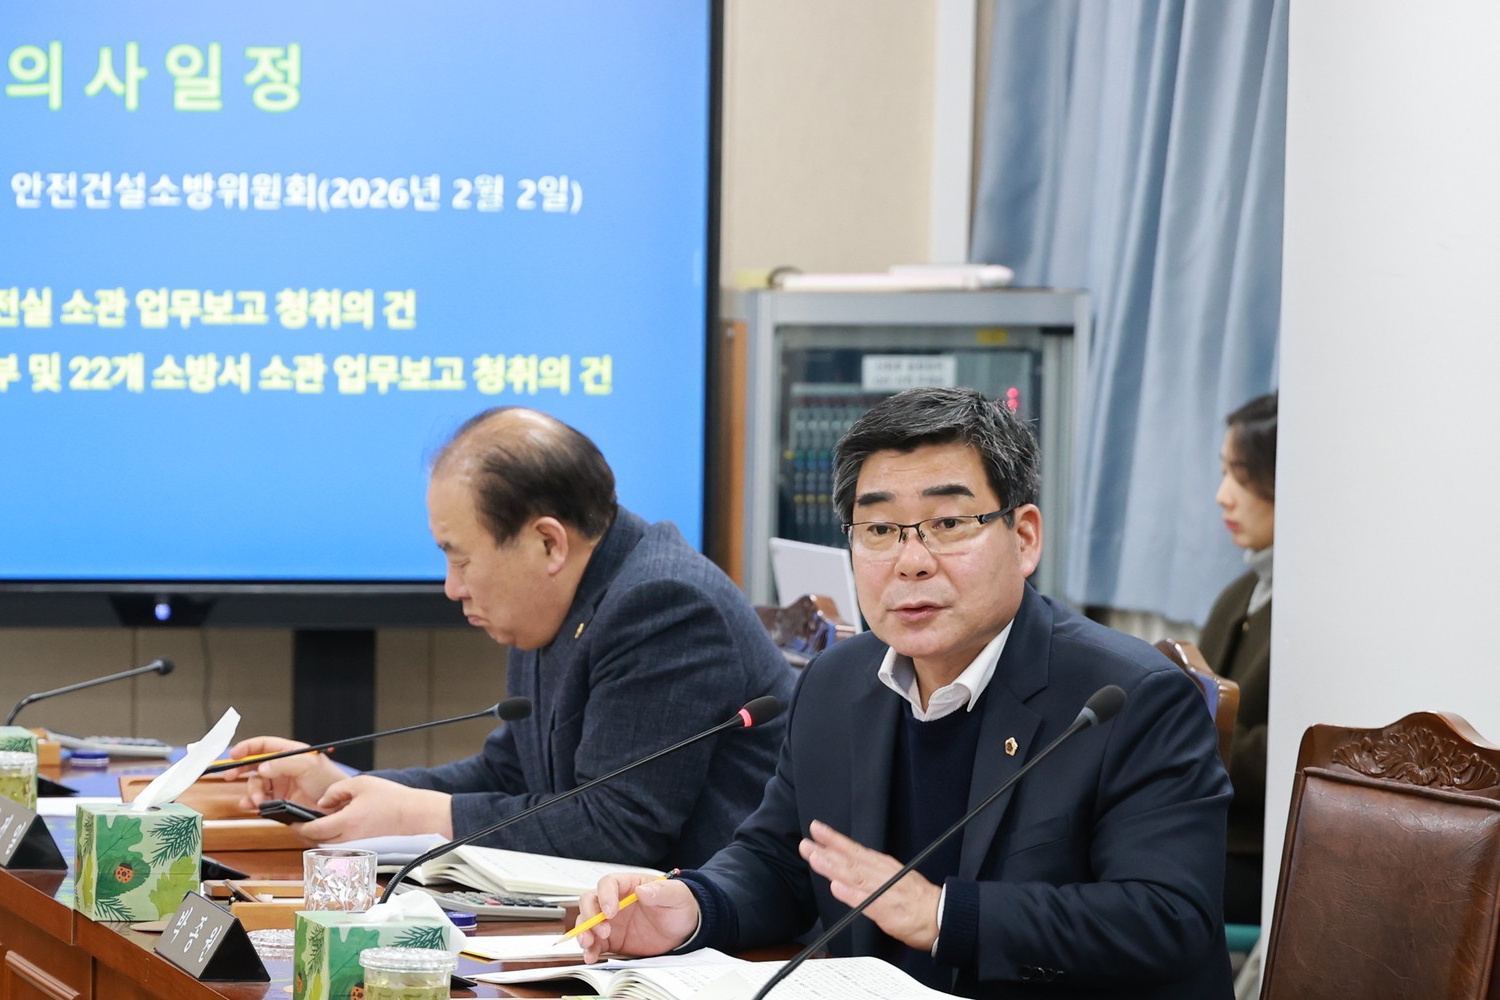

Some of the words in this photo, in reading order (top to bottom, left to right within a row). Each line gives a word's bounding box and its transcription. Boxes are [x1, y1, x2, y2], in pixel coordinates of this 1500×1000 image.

[5, 40, 301, 113] 의사일정
[451, 174, 505, 212] 2월
[516, 174, 584, 215] 2일)
[60, 288, 127, 328] 소관
[135, 287, 268, 329] 업무보고
[275, 287, 375, 330] 청취의
[382, 289, 417, 330] 건
[29, 352, 62, 394] 및
[69, 352, 145, 394] 22개
[151, 352, 250, 394] 소방서
[258, 353, 327, 394] 소관
[333, 354, 466, 395] 업무보고
[472, 354, 572, 396] 청취의
[579, 355, 614, 396] 건
[170, 906, 223, 963] 박종원
